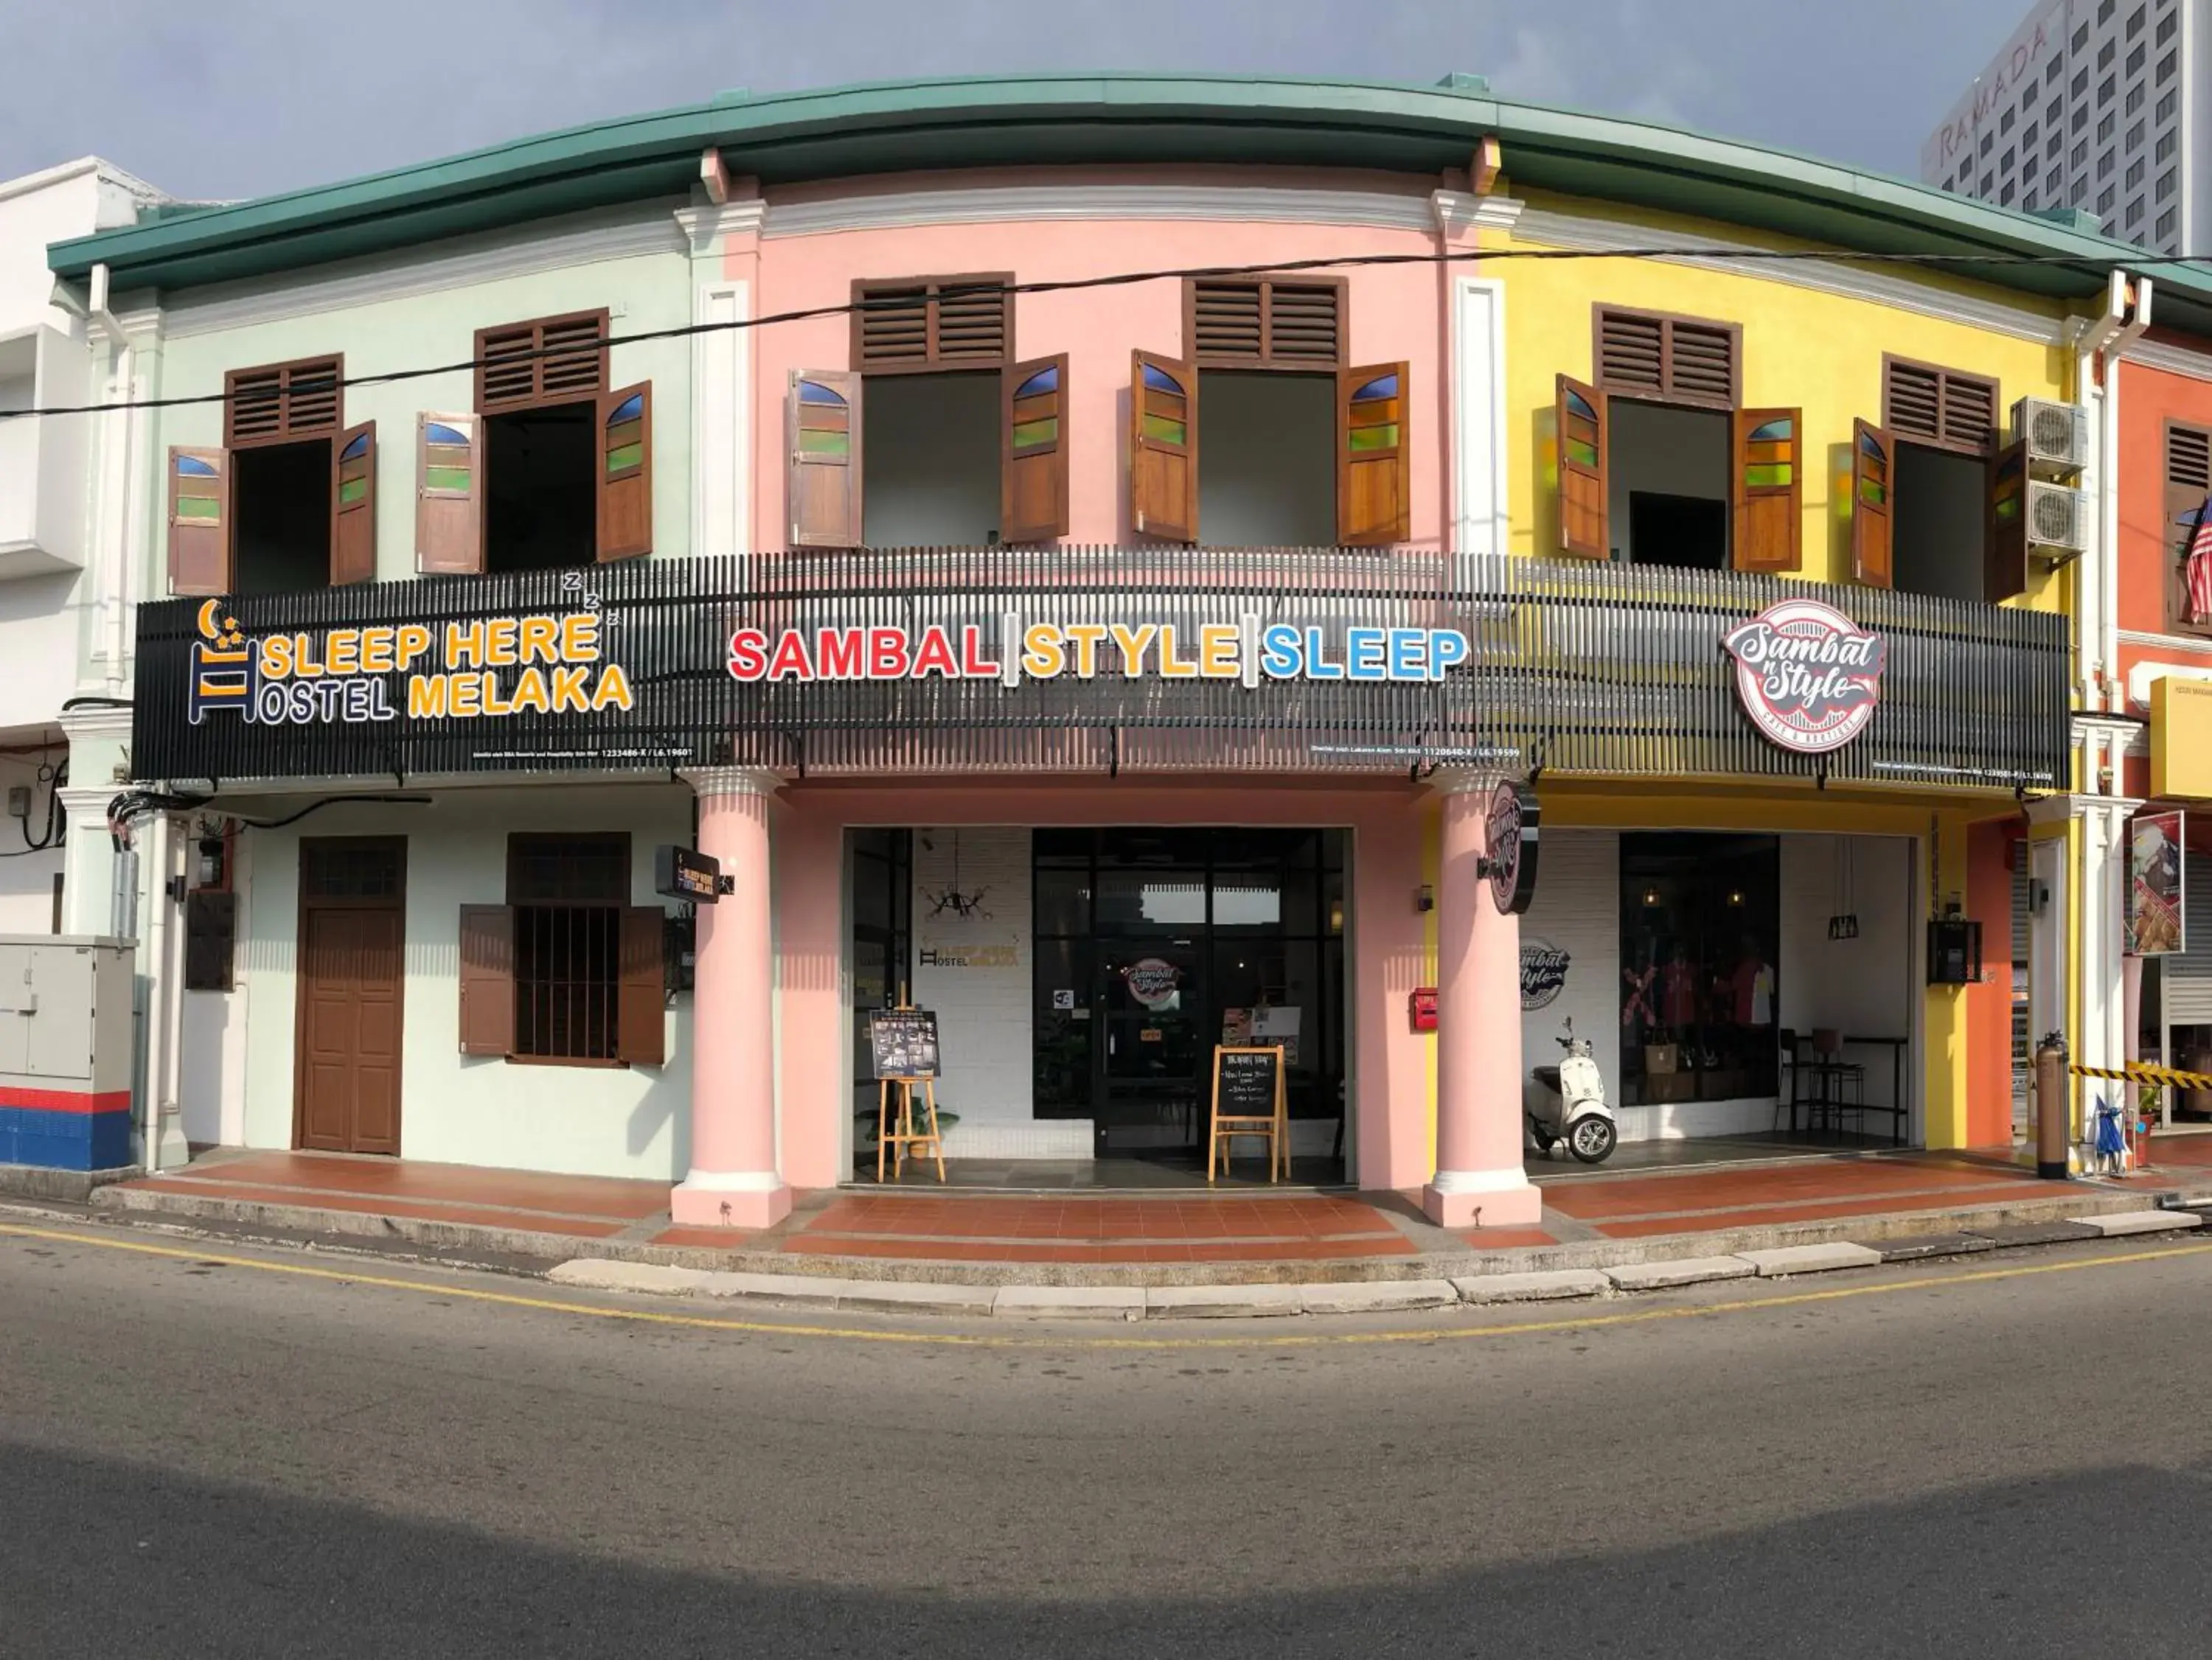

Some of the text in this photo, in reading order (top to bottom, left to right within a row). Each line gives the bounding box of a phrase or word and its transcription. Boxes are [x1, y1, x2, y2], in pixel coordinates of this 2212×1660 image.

[1941, 21, 2048, 168] RAMADA
[260, 613, 599, 680] SLEEP HERE
[726, 626, 1001, 682] SAMBAL
[1022, 624, 1241, 680] STYLE
[1260, 624, 1470, 683] SLEEP
[1739, 626, 1875, 666] Sambal
[408, 663, 633, 719] MELAKA
[1763, 660, 1863, 708] Style
